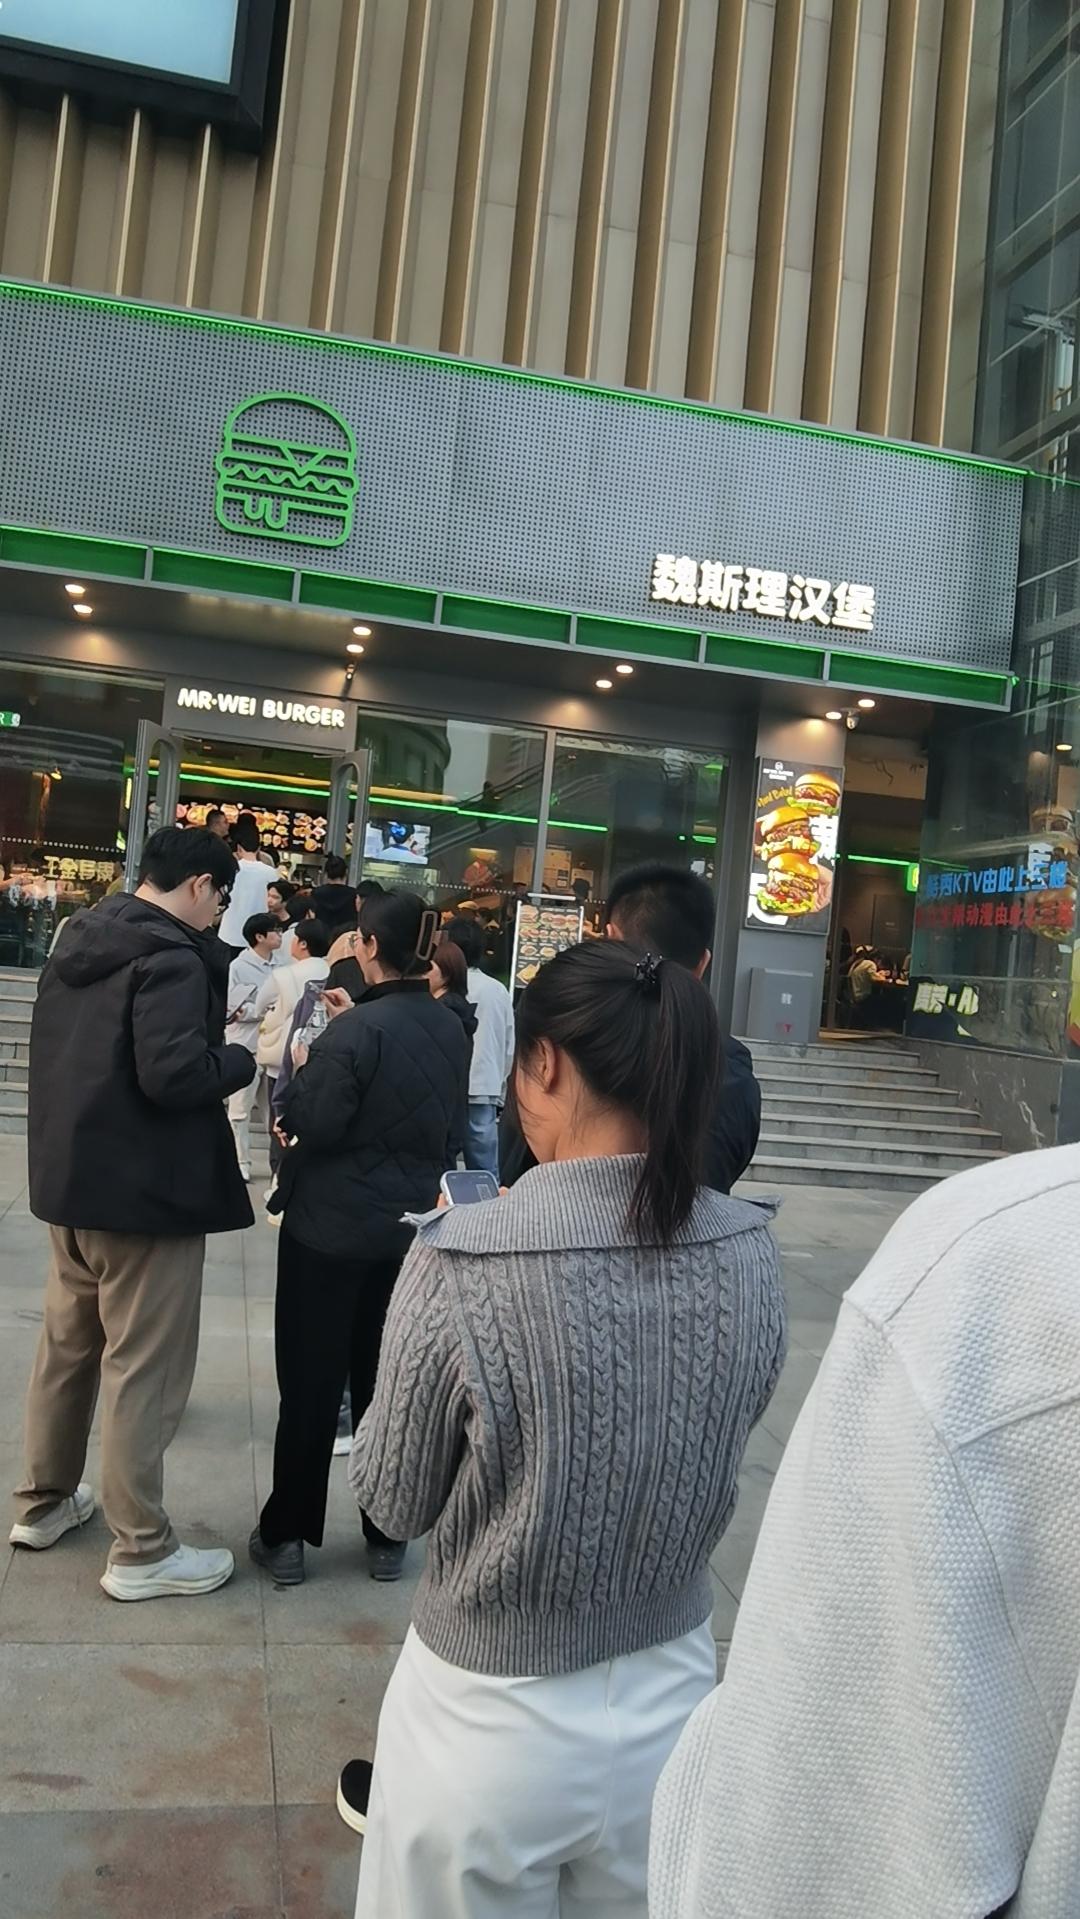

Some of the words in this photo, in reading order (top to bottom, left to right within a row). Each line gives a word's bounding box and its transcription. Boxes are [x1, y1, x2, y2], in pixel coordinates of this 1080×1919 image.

[652, 553, 876, 631] 魏斯理汉堡
[262, 699, 345, 727] BURGER
